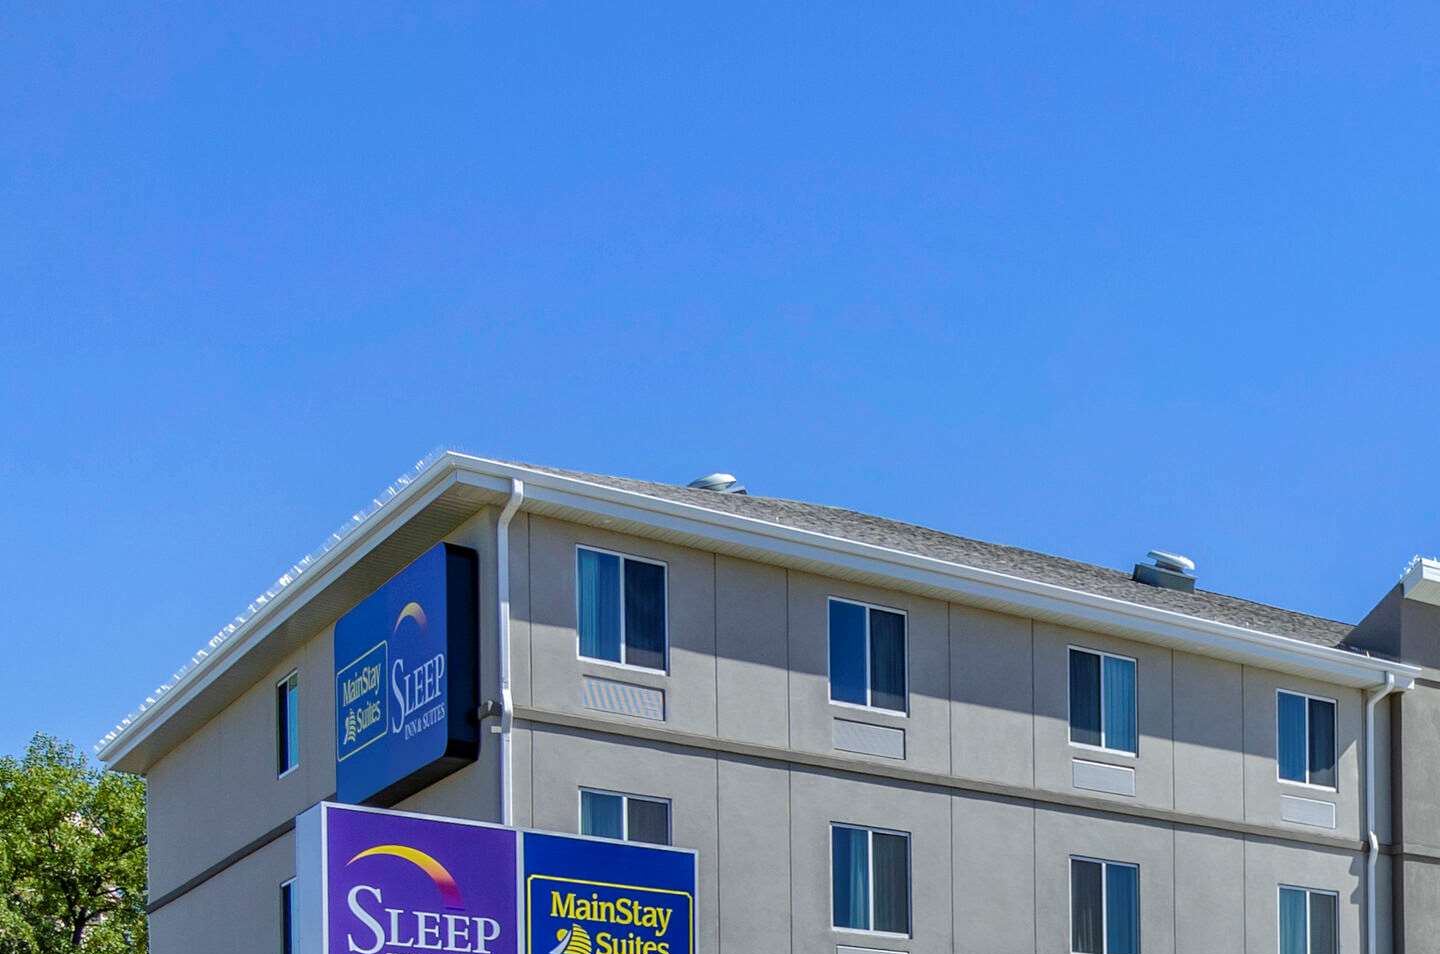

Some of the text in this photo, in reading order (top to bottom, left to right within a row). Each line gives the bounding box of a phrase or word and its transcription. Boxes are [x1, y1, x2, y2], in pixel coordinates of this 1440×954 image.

[343, 664, 381, 707] MainStay
[392, 653, 445, 733] SLEEP
[356, 700, 381, 733] Suites
[404, 719, 417, 740] INN
[422, 702, 446, 729] SUITES
[347, 885, 501, 954] SLEEP
[550, 890, 673, 937] MainStay
